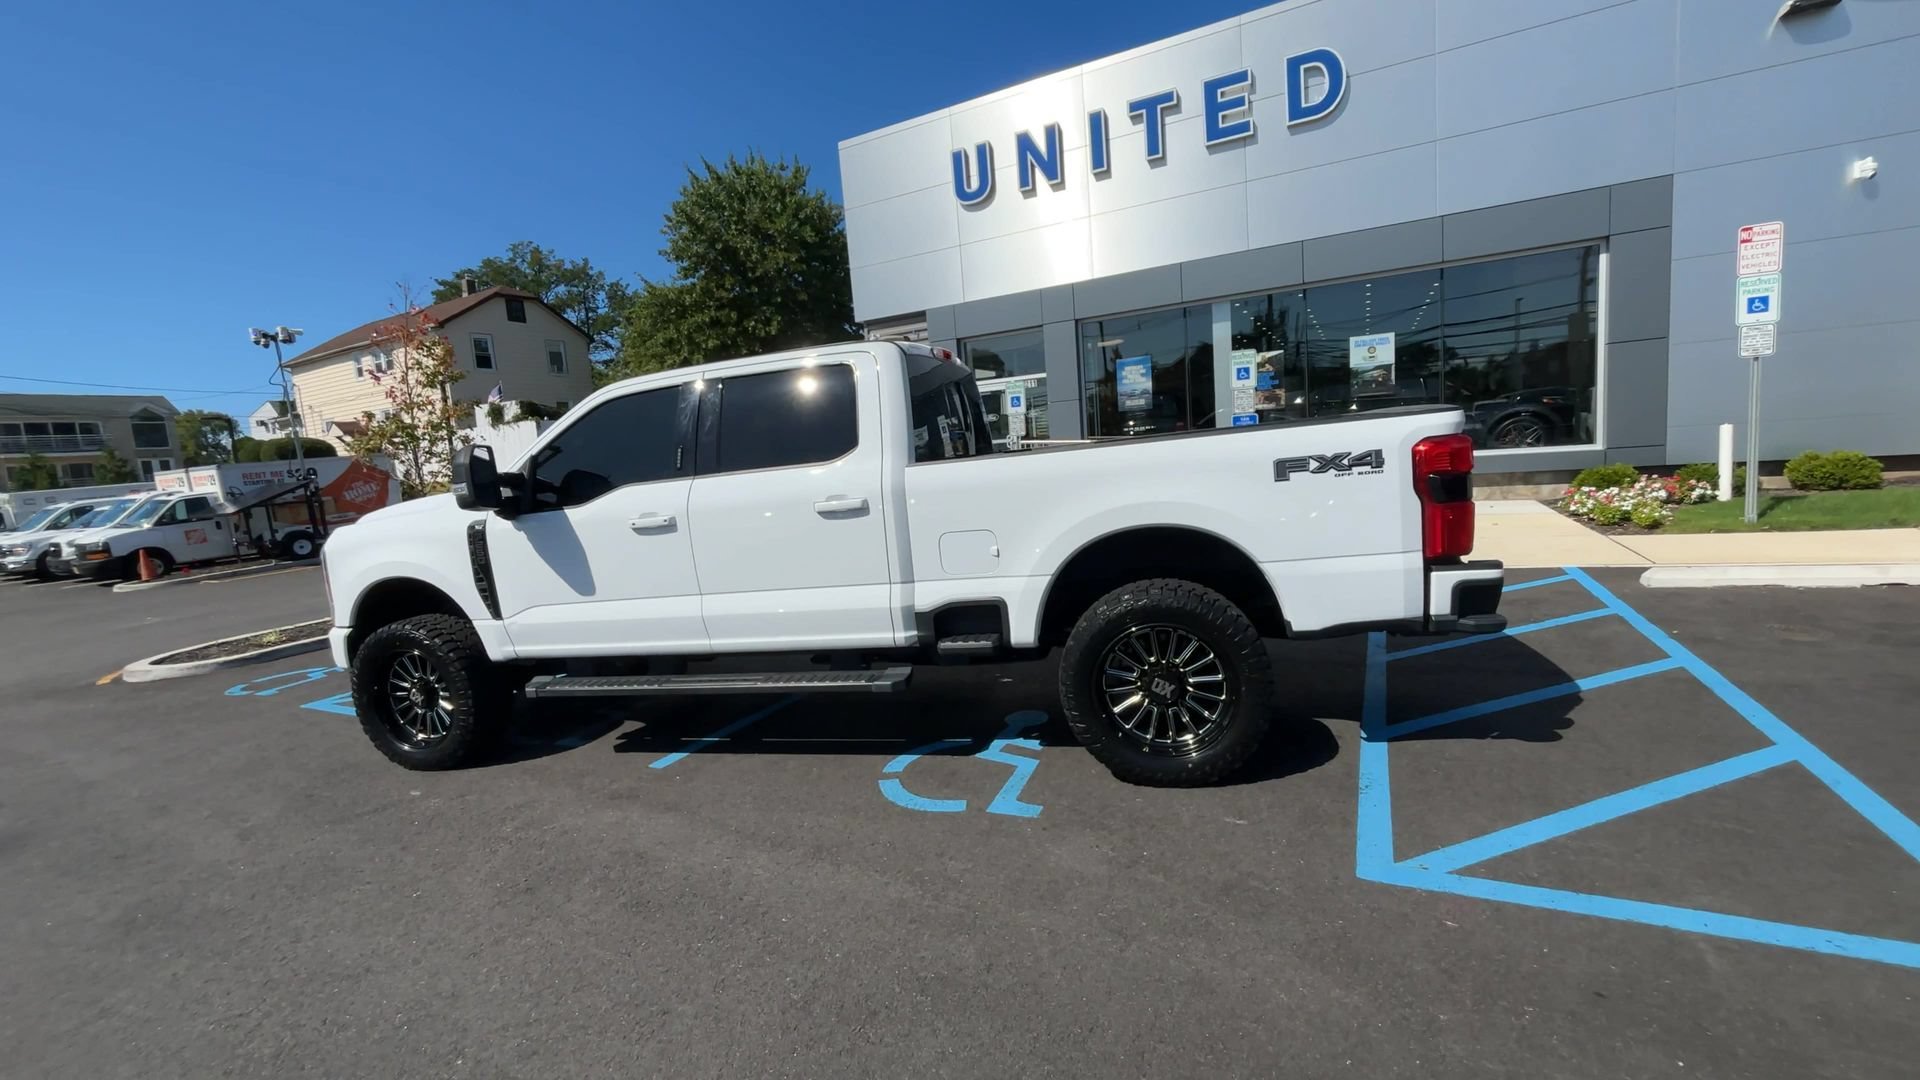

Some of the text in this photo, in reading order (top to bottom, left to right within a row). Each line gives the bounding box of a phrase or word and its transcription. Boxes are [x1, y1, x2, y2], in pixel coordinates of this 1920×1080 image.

[951, 47, 1347, 205] UNITED
[1741, 229, 1779, 241] NO PARKING
[1743, 242, 1776, 251] EXCEPT
[1742, 252, 1777, 261] ELECTRIC
[1742, 260, 1777, 270] VEHICLES
[1273, 448, 1385, 482] FX4
[241, 471, 267, 480] RENT
[270, 470, 285, 479] ME
